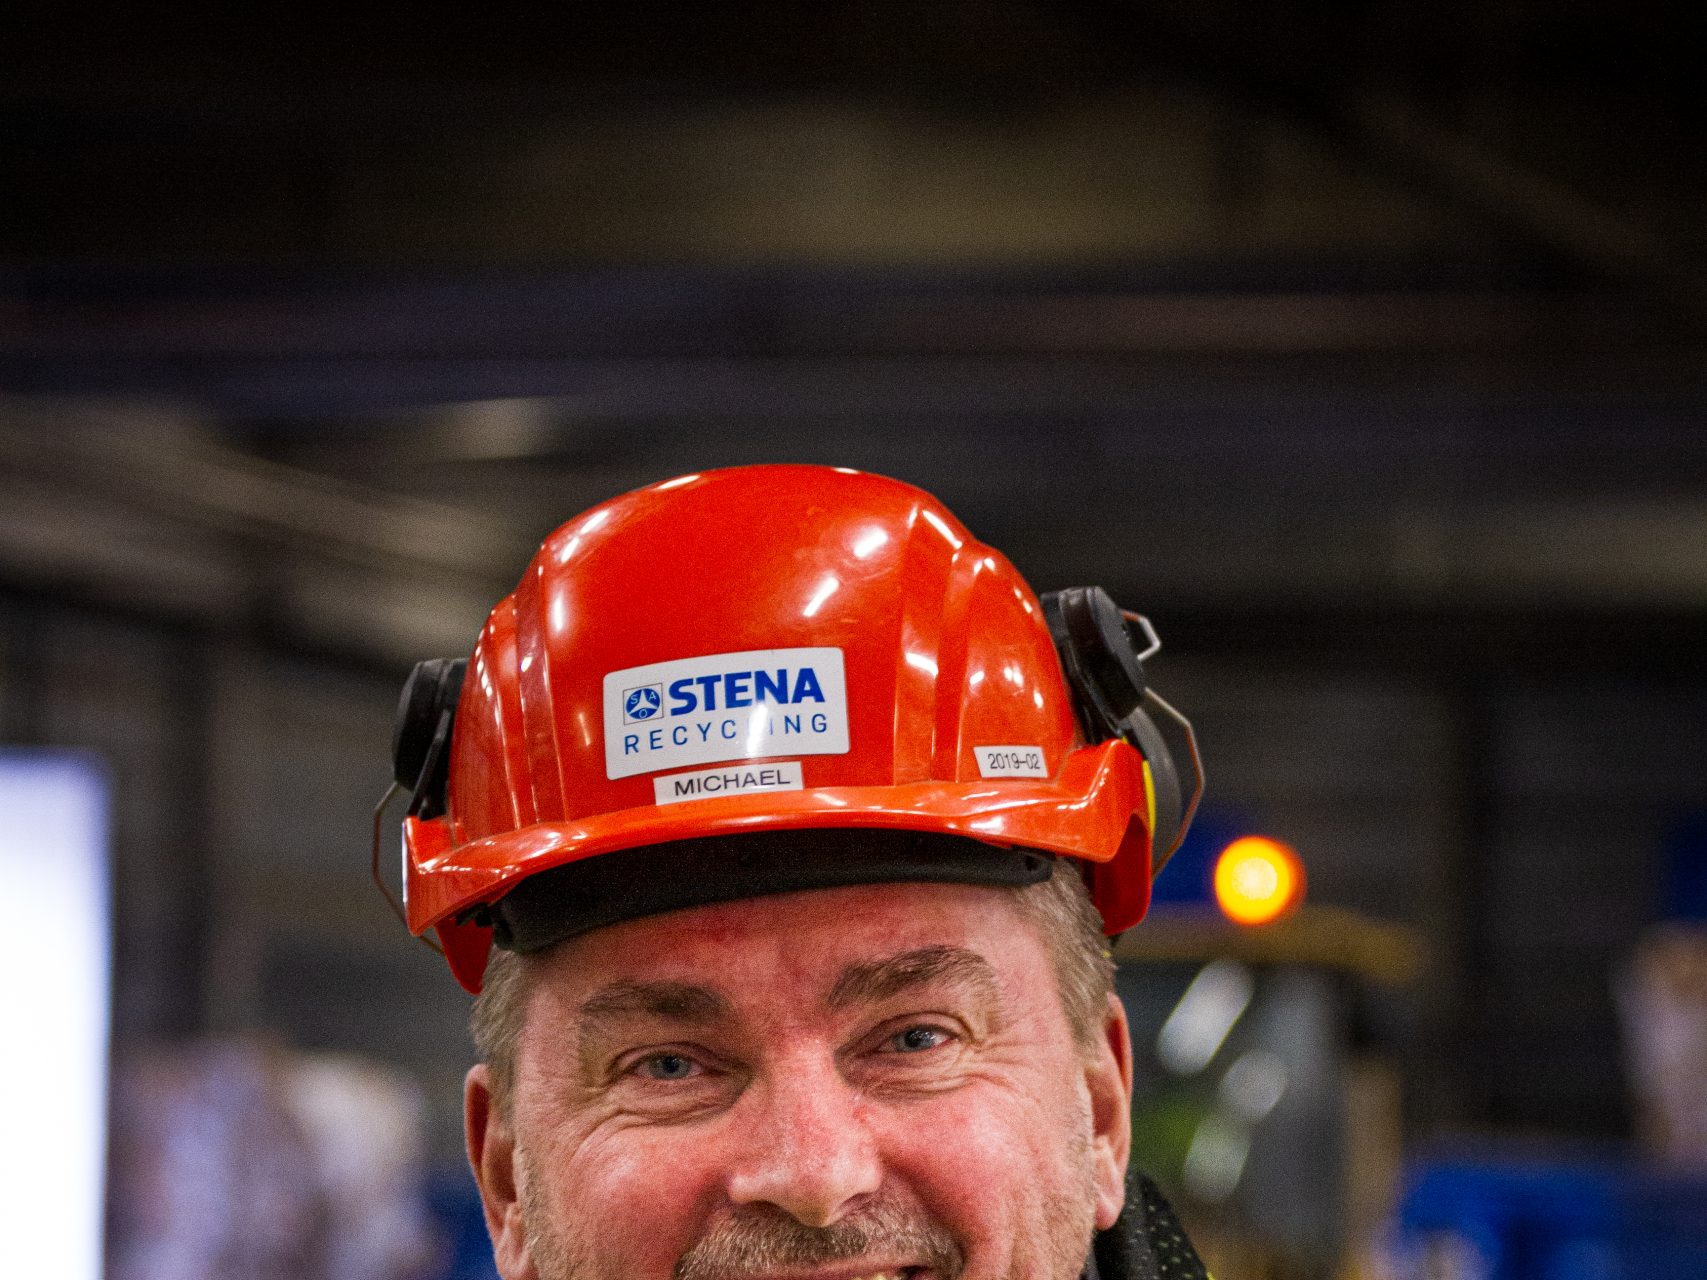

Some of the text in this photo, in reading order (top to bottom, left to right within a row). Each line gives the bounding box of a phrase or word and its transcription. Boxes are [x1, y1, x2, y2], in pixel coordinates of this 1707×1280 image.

[668, 667, 826, 717] STENA
[624, 713, 828, 755] RECYCING
[987, 752, 1041, 770] 2019-02
[673, 768, 792, 797] MICHAEL
